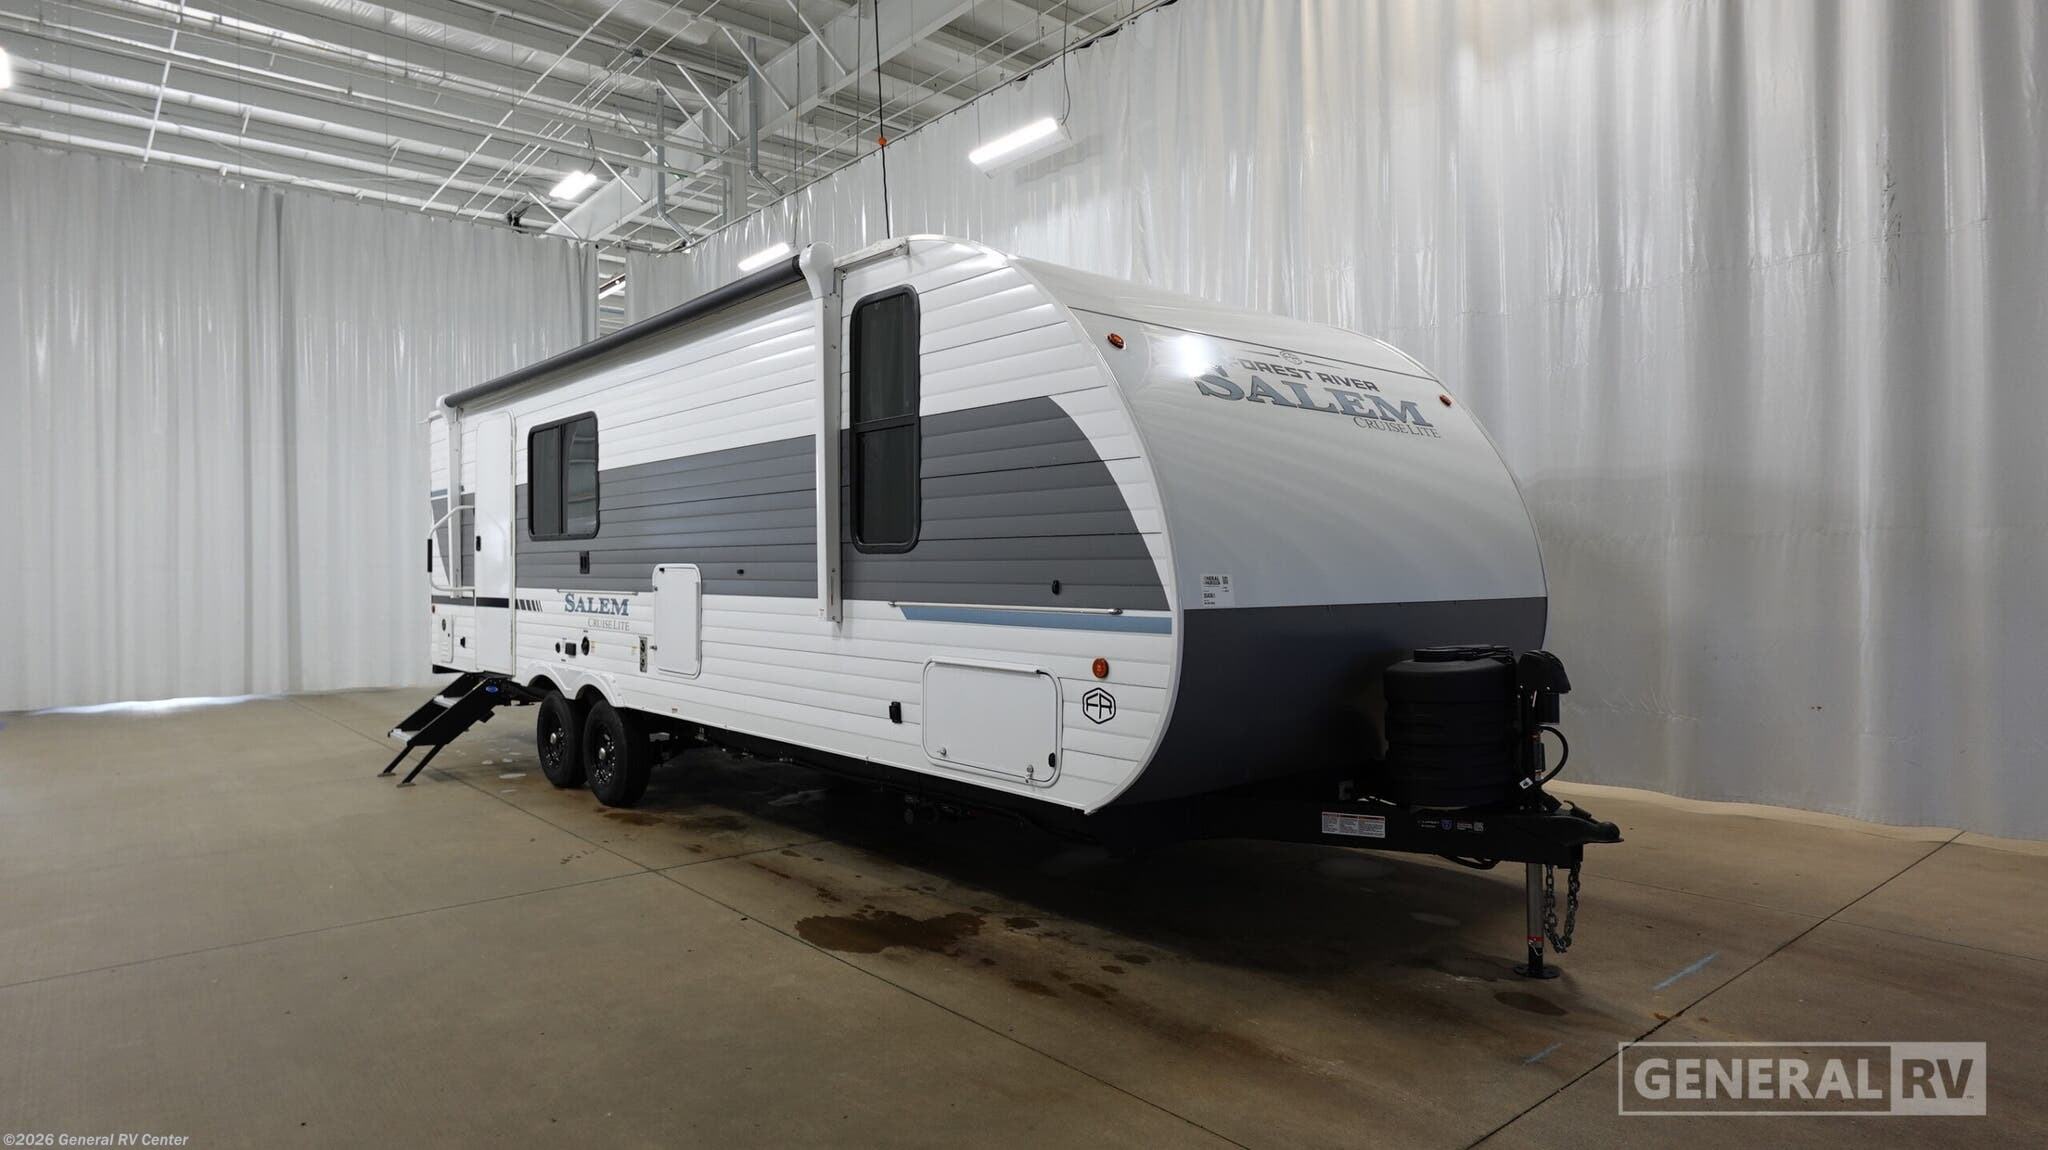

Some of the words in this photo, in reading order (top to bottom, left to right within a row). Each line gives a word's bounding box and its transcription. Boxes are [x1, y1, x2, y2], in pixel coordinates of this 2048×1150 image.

[1232, 358, 1313, 381] OREST
[1317, 371, 1380, 392] RIVER
[1194, 363, 1434, 428] SALEM
[564, 592, 629, 616] SALEM
